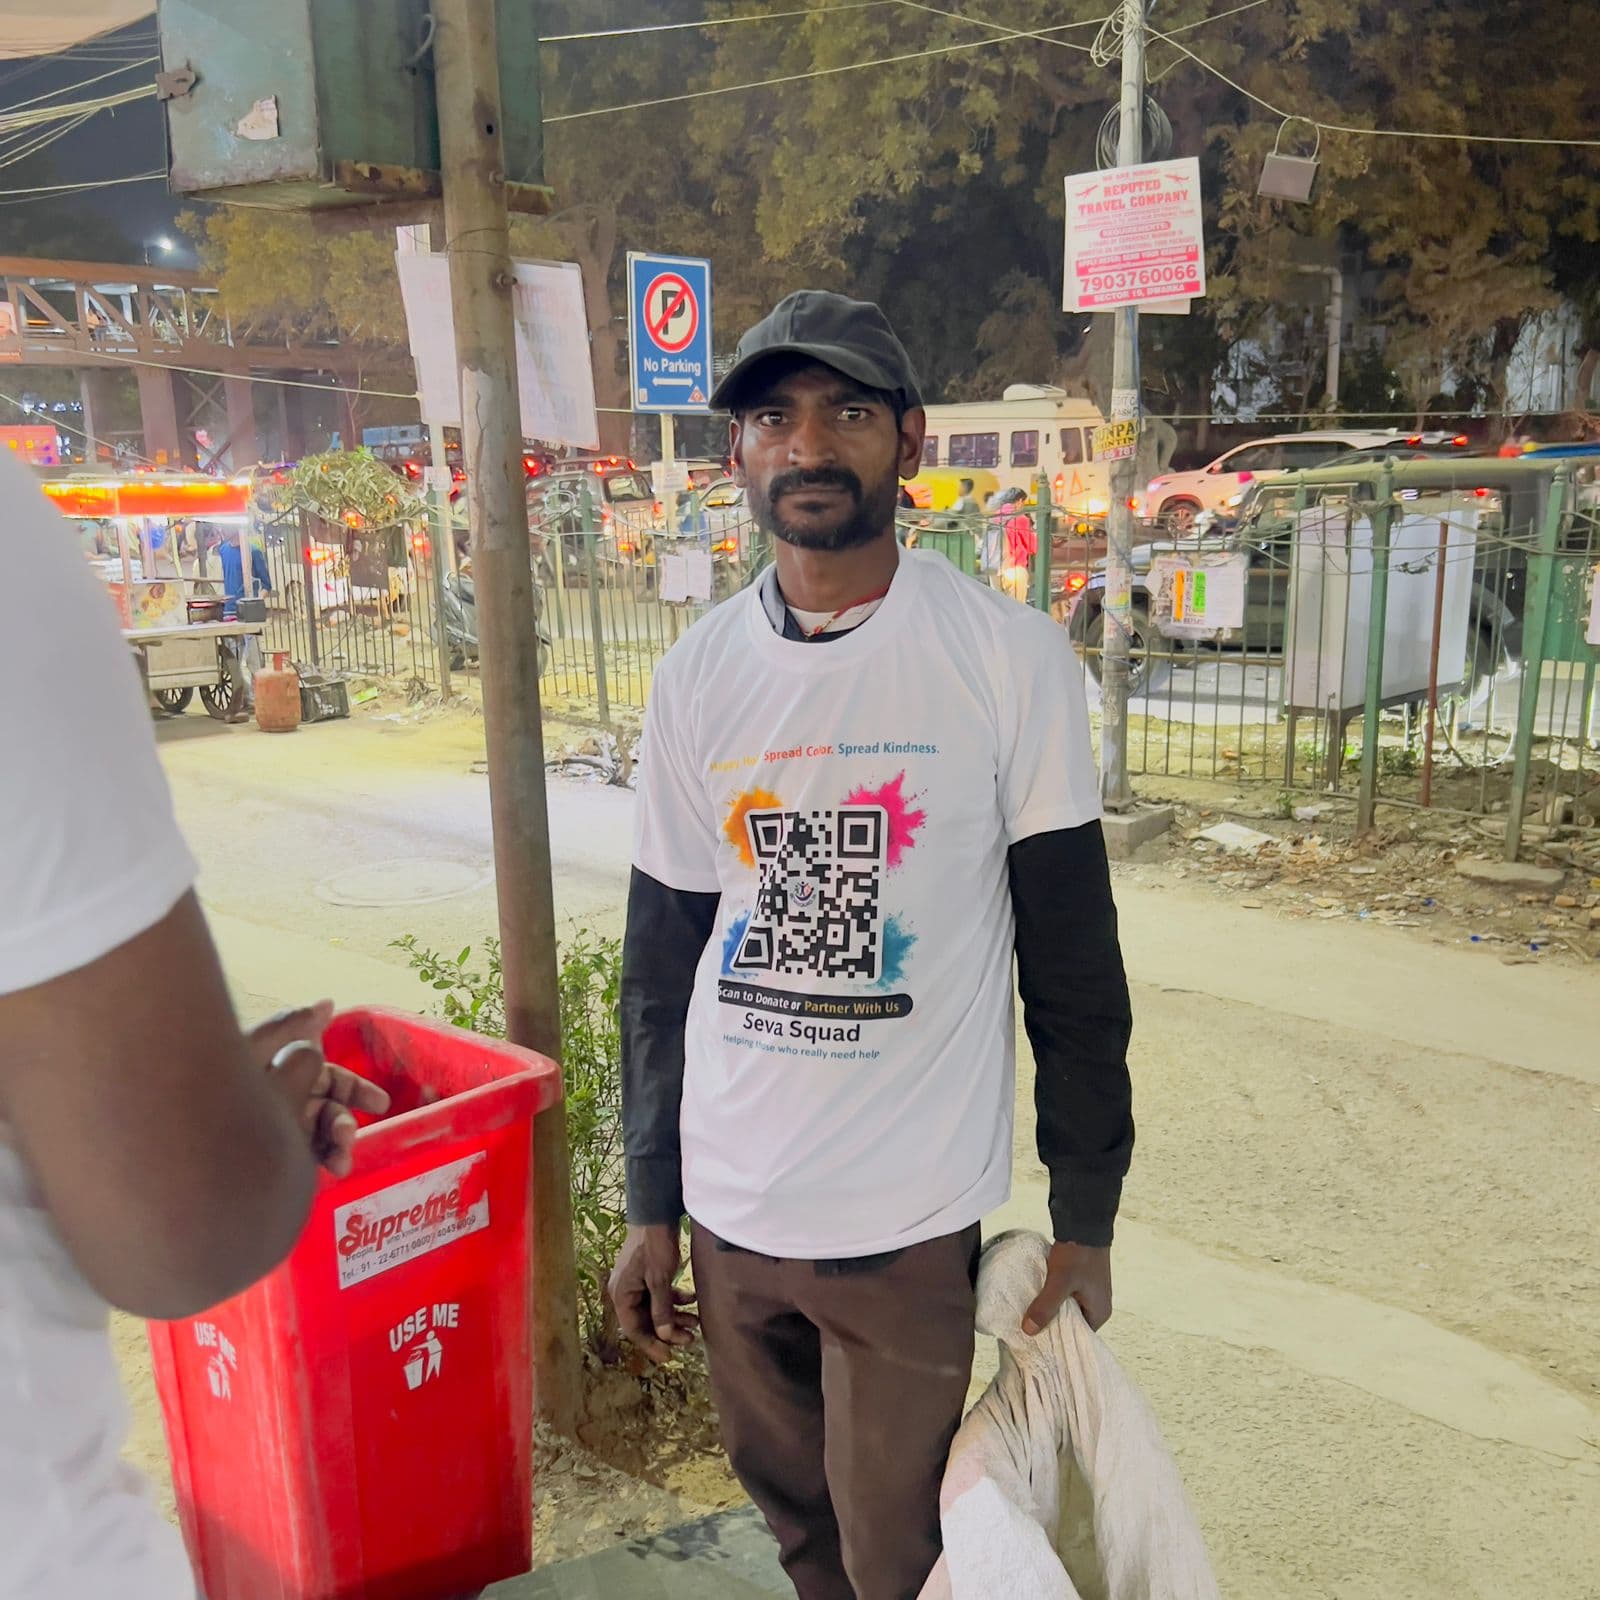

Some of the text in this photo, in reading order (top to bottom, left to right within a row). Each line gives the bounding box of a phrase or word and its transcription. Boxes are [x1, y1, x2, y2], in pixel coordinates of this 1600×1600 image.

[1103, 178, 1160, 197] REPUTED
[1078, 198, 1125, 215] TRAVEL
[1130, 189, 1188, 208] COMPANY
[1080, 263, 1196, 292] 7903760066
[643, 357, 702, 377] No Parking
[764, 746, 802, 762] Spread
[838, 742, 880, 756] Spread
[883, 740, 940, 755] Kindness.
[718, 985, 900, 1014] Scan to Donate or Partner With Us
[743, 1012, 861, 1045] Seva Squad
[723, 1033, 754, 1049] Helping
[778, 1045, 799, 1055] who
[800, 1047, 828, 1060] really
[830, 1050, 856, 1060] need
[193, 1320, 218, 1348] USE
[389, 1303, 460, 1353] USE ME
